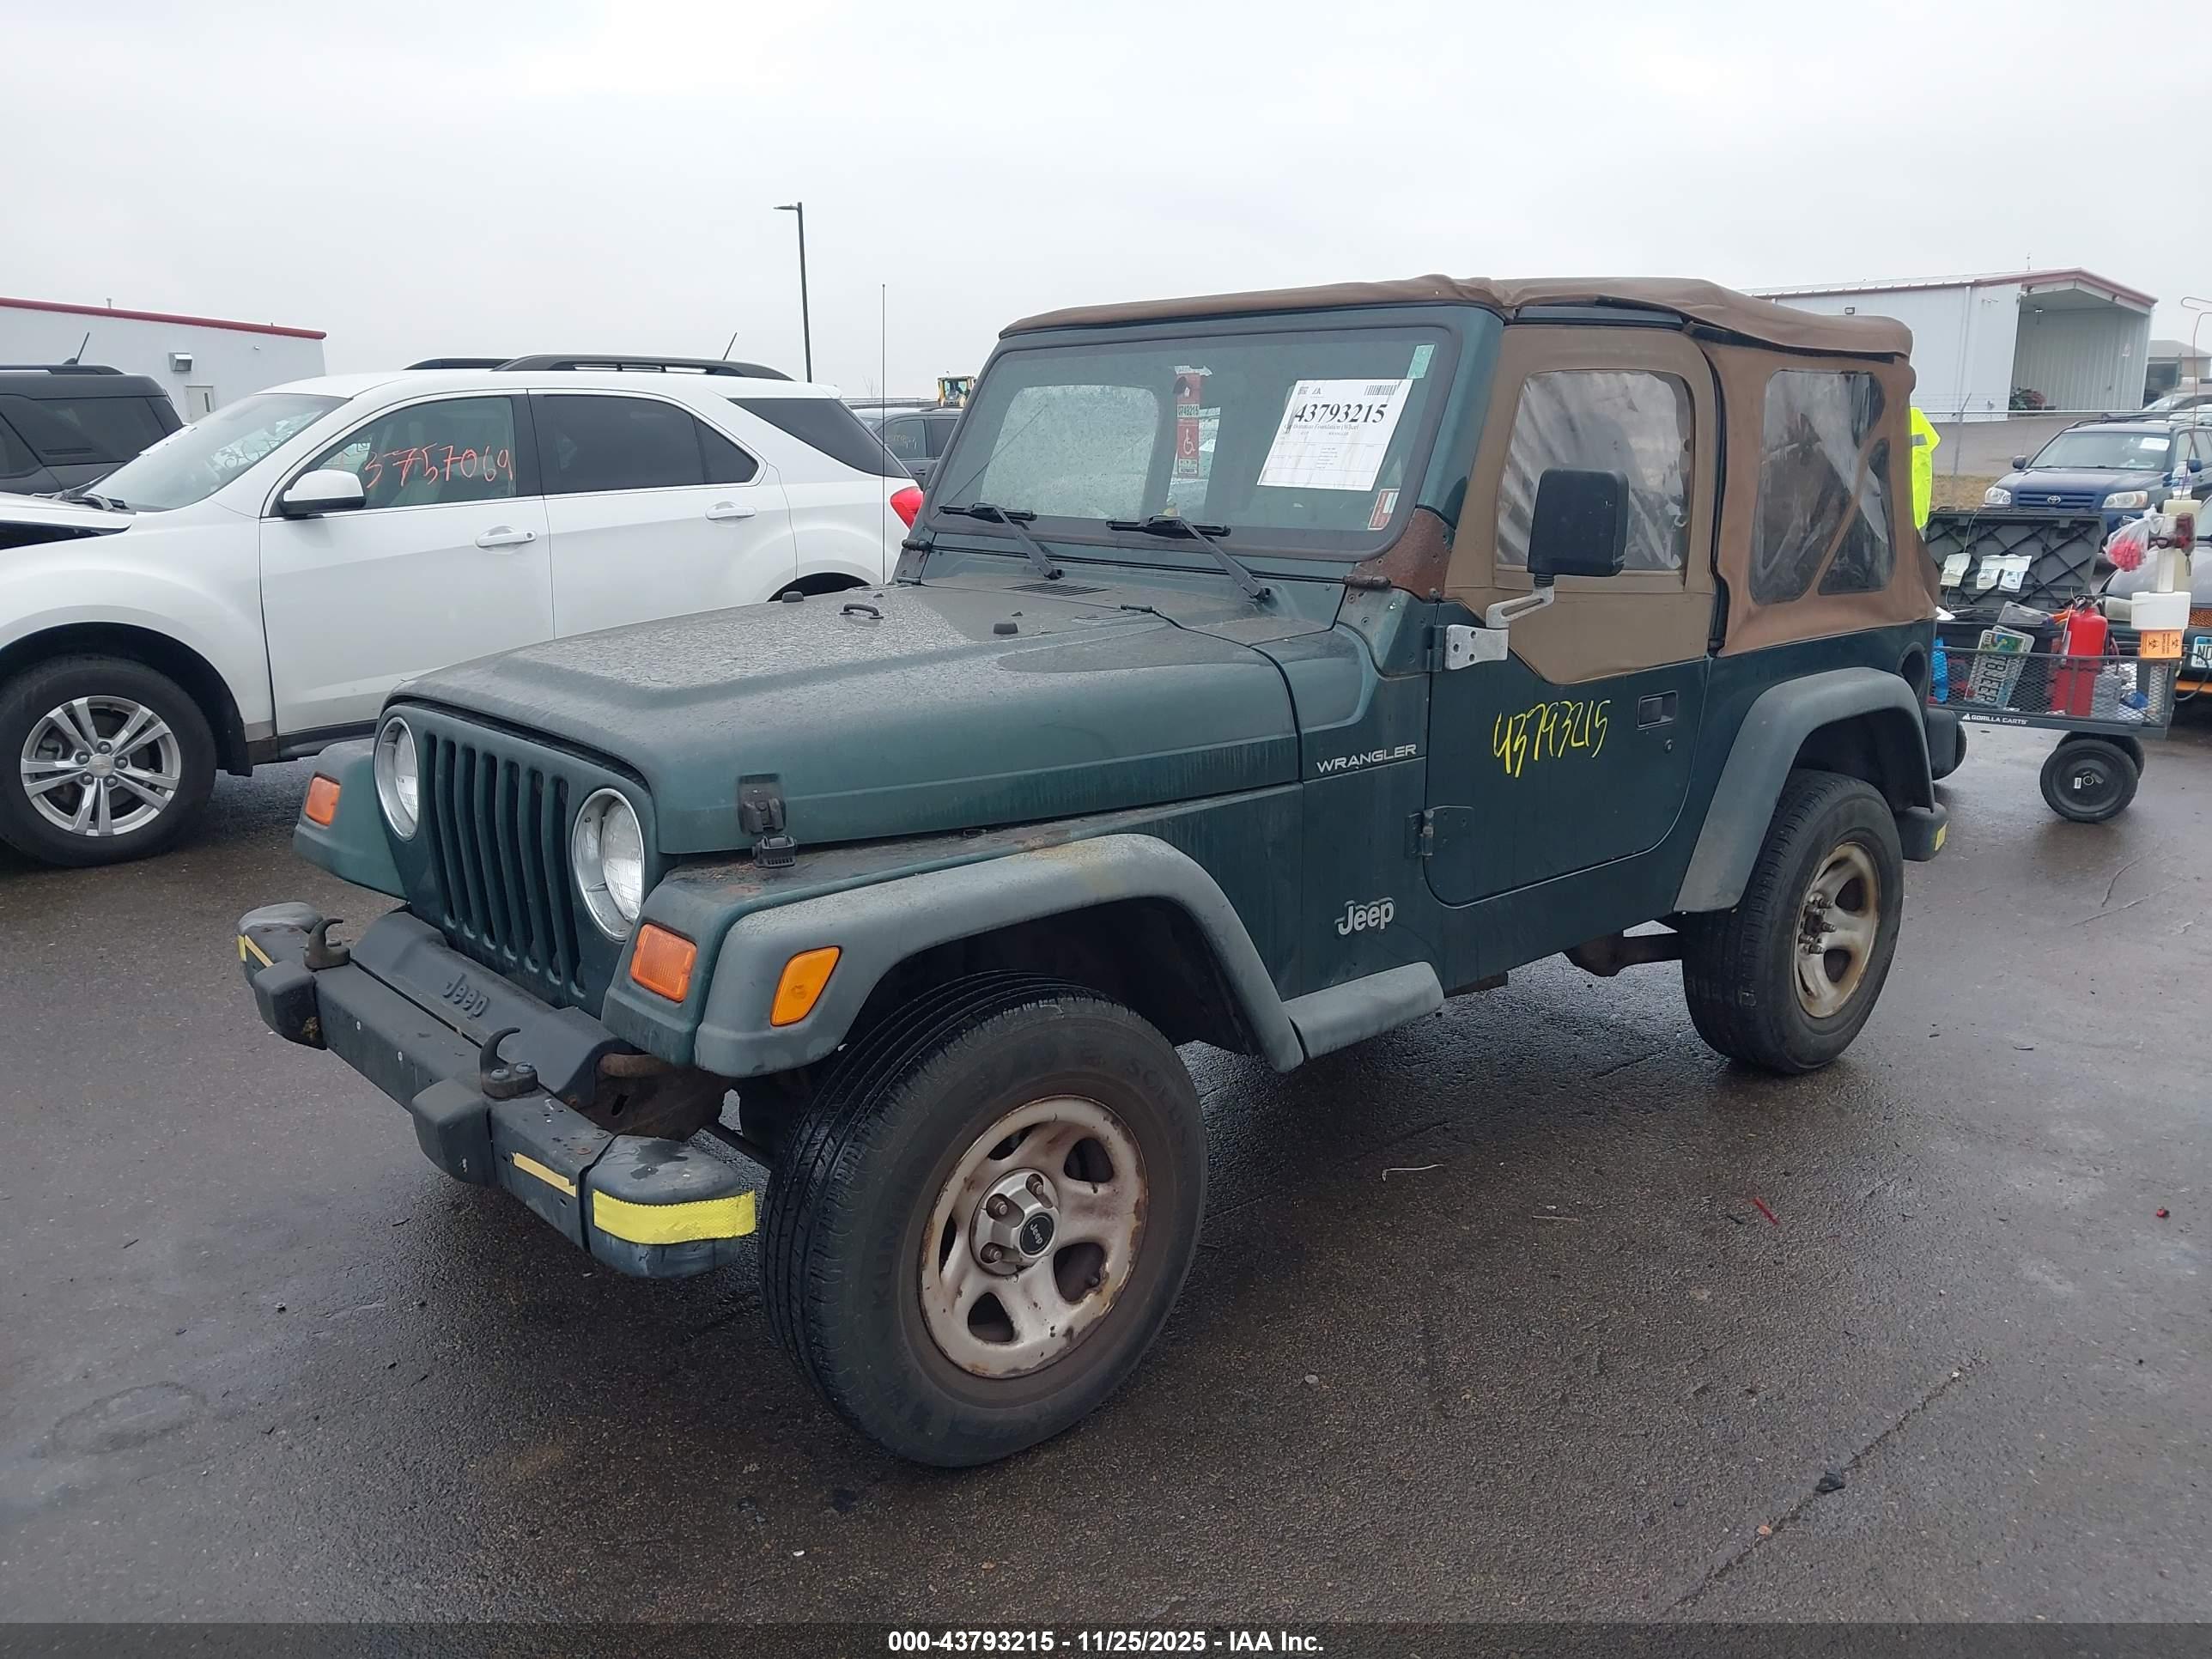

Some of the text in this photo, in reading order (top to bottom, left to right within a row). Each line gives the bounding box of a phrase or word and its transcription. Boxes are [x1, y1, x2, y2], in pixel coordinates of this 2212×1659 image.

[1295, 404, 1389, 423] 43793215
[1493, 700, 1611, 778] 43793215
[1316, 744, 1417, 773] WRANGLER
[1336, 899, 1395, 936] Jeep
[442, 973, 490, 1020] Jeep
[1030, 1224, 1043, 1244] Jeep
